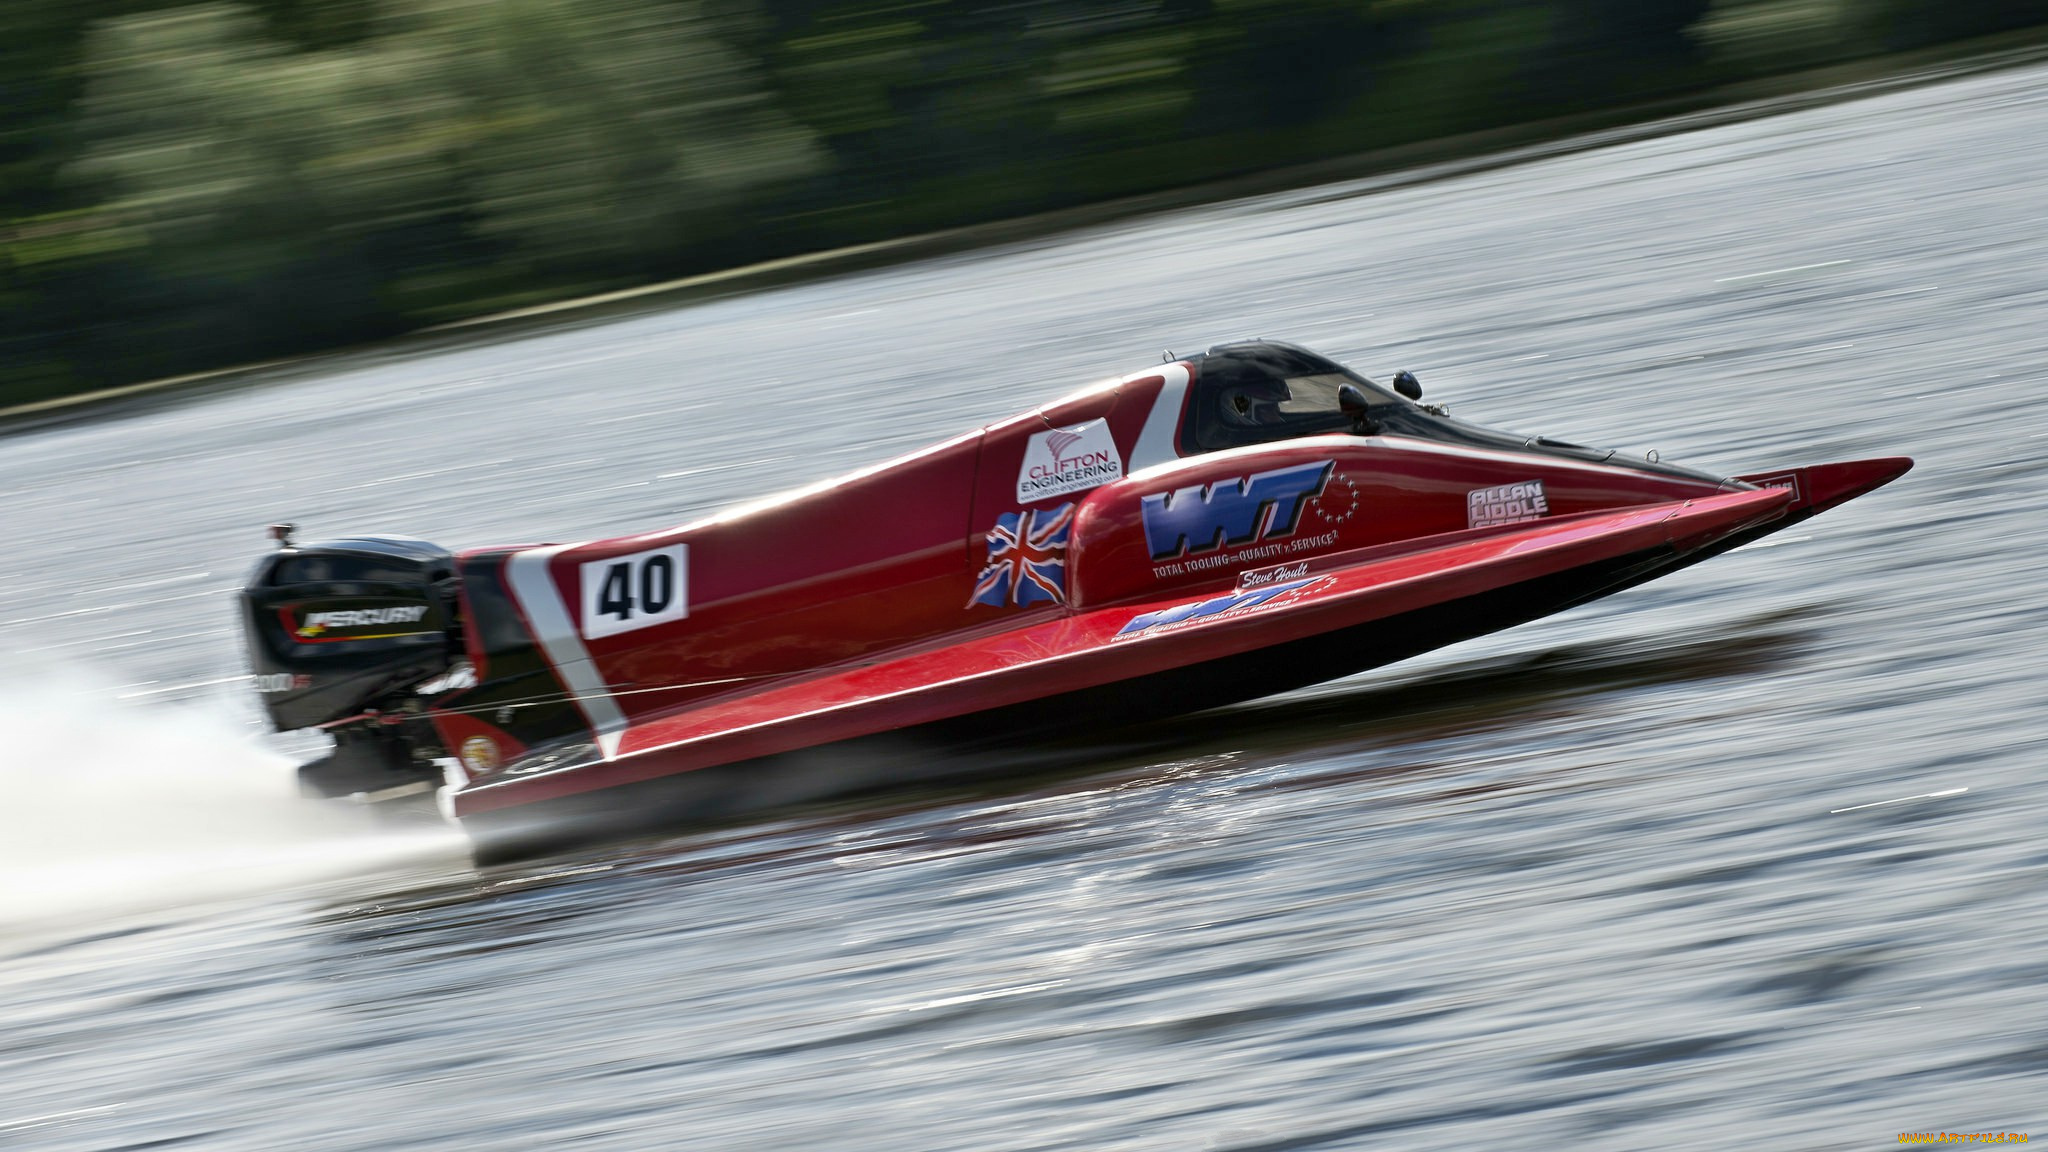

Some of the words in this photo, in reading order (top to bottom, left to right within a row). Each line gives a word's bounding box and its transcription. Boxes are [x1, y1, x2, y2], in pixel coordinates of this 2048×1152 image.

[1021, 461, 1118, 492] ENGINEERING
[1029, 450, 1109, 479] CLIFTON
[1471, 483, 1543, 506] ALLAN
[1471, 496, 1548, 520] LIDDLE
[1152, 564, 1185, 579] TOTAL
[1186, 554, 1229, 572] TOOLING
[1239, 543, 1283, 562] QUALITY
[596, 553, 674, 621] 40
[1241, 568, 1273, 589] Steve
[1274, 562, 1308, 583] Hoult
[303, 605, 430, 629] MERCURY
